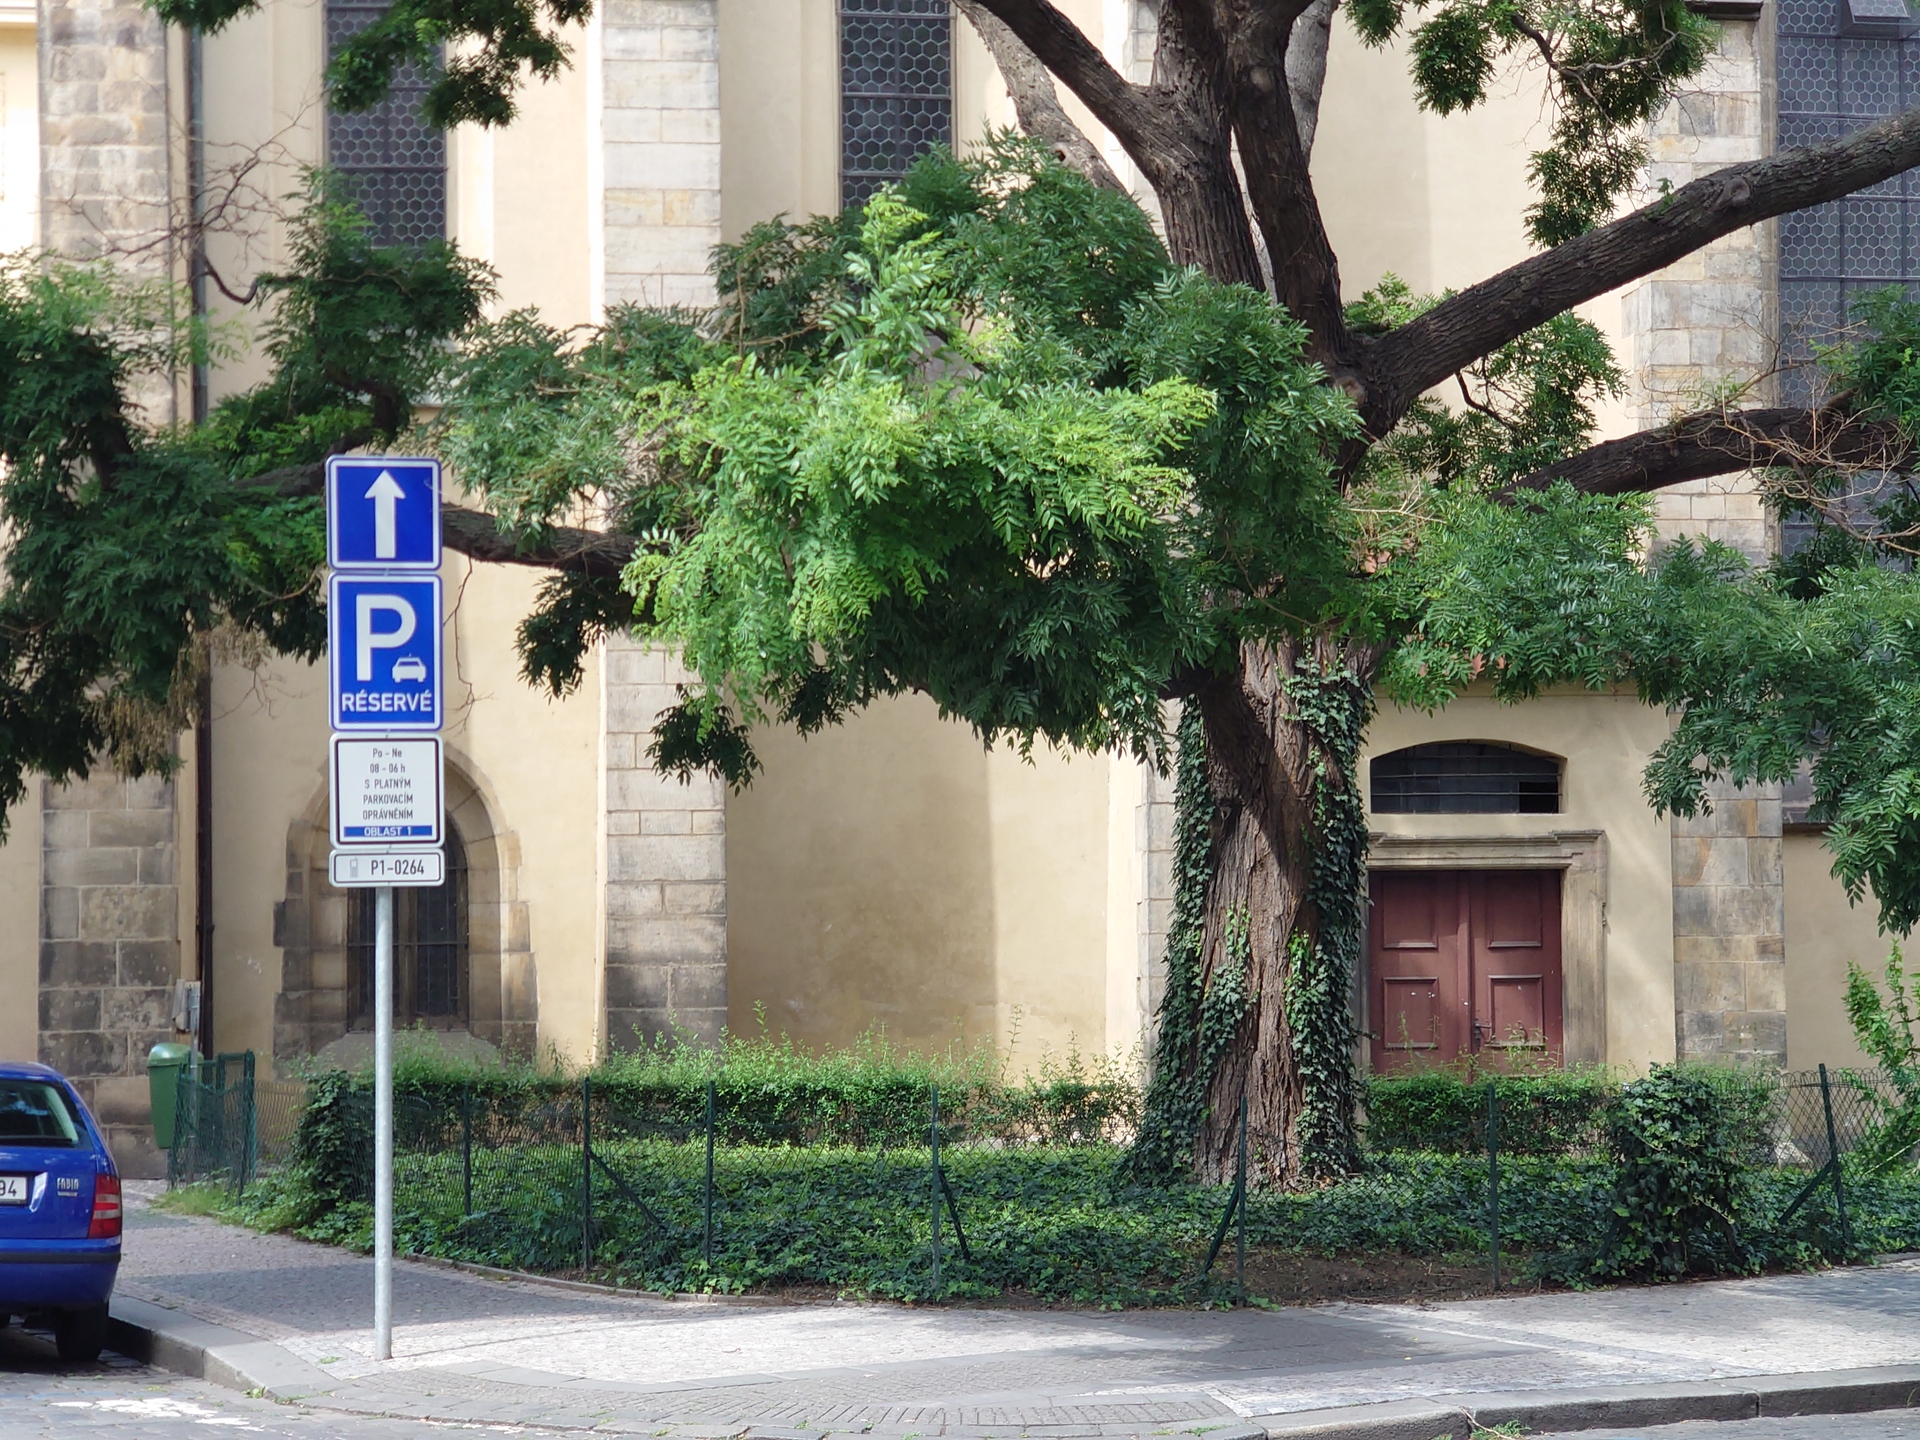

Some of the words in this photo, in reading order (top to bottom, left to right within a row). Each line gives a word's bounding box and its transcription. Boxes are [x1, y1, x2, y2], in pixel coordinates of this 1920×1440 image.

[356, 594, 416, 681] P
[341, 689, 432, 712] RÉSERVÉ
[372, 748, 383, 758] Po
[392, 748, 403, 758] Ne
[369, 763, 380, 773] 08
[388, 763, 399, 773] 06
[400, 763, 406, 773] h
[364, 779, 370, 789] S
[374, 777, 411, 789] PLATNÝM
[363, 792, 413, 805] PARKOVACÍM
[362, 807, 413, 820] OPRÁVNĚNÍM
[363, 826, 401, 837] OBLAST
[406, 826, 412, 836] 1
[370, 859, 425, 876] P1-0264
[56, 1177, 79, 1190] FABIA
